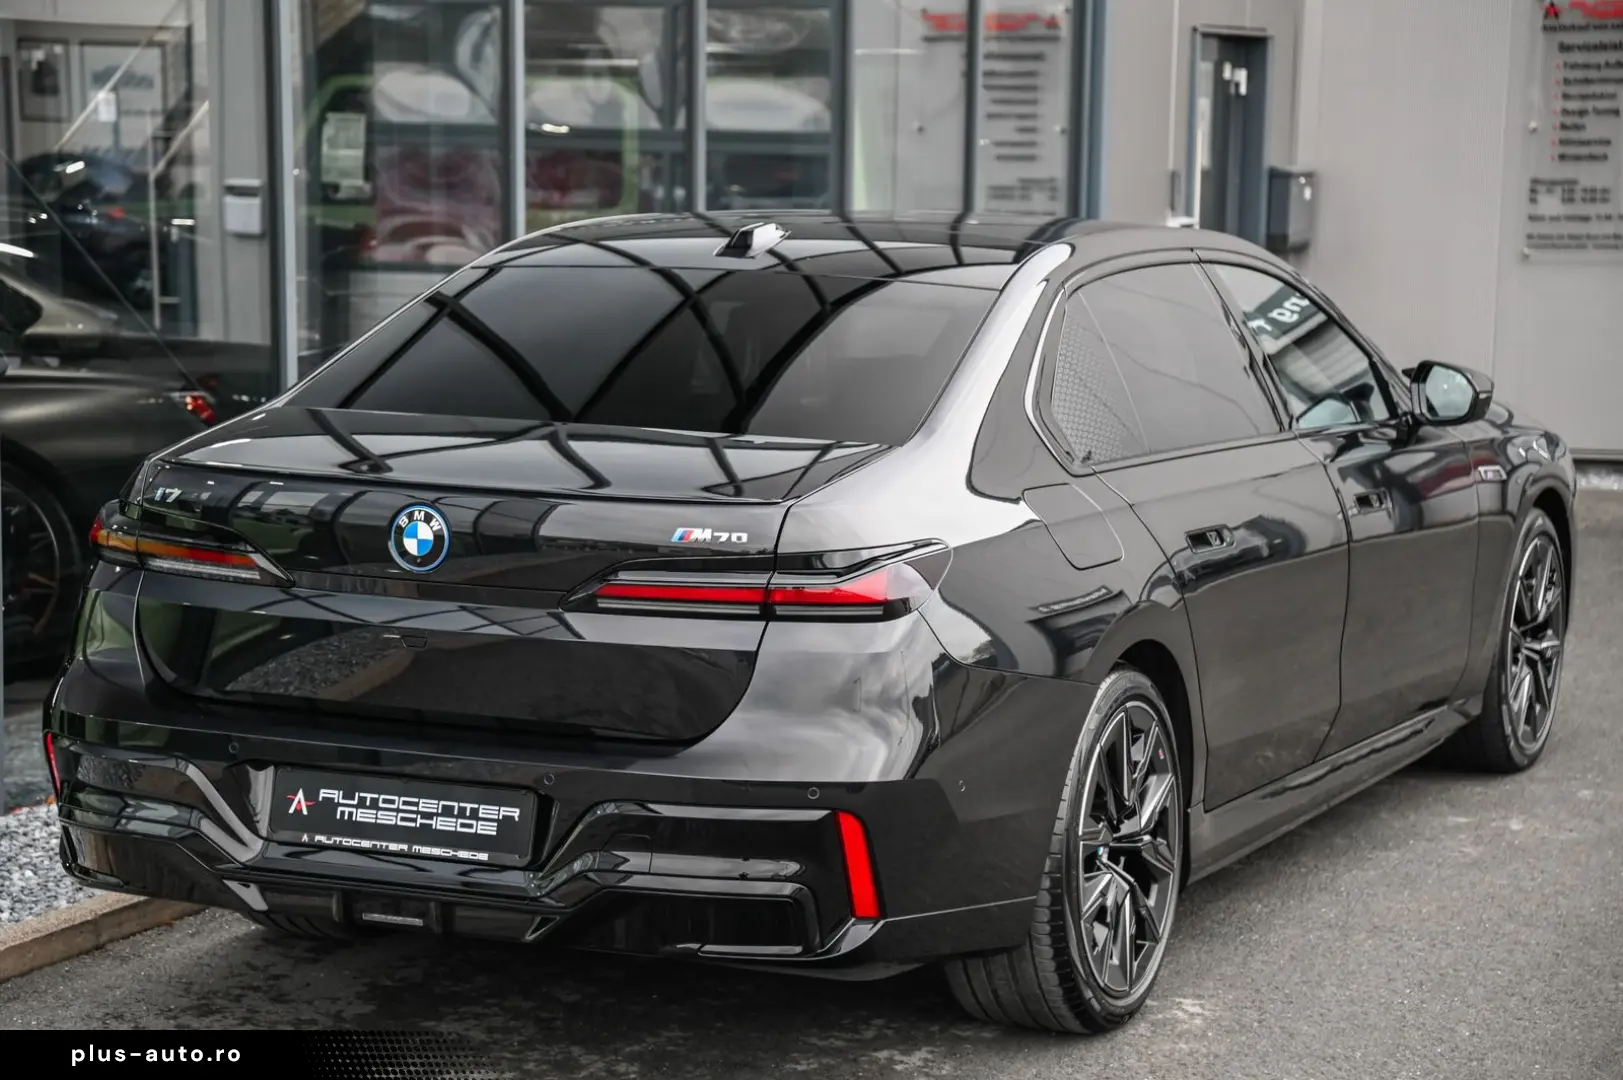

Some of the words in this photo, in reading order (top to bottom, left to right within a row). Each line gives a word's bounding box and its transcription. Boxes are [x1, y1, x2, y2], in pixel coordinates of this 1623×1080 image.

[399, 510, 442, 532] BMW
[318, 788, 521, 822] AUTOCENTER
[336, 806, 498, 836] MESCHEDE
[314, 834, 408, 852] AUTOCENTER
[412, 845, 489, 861] MESCHEDE
